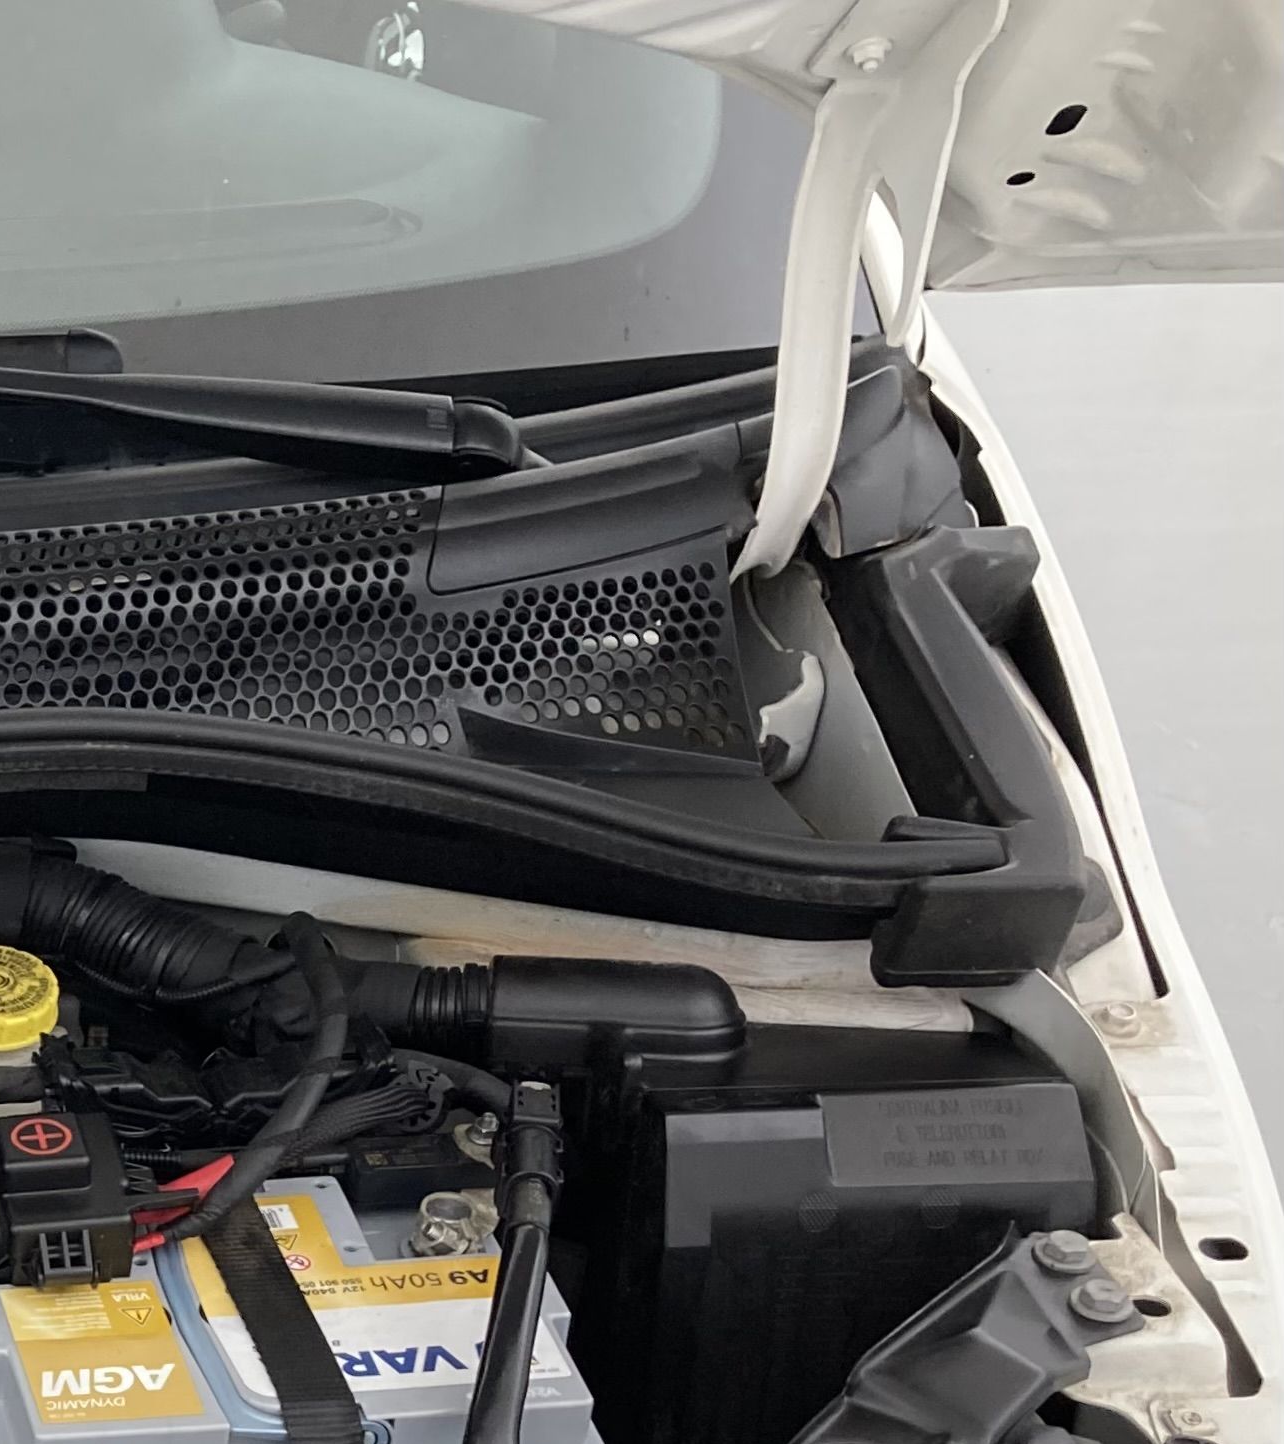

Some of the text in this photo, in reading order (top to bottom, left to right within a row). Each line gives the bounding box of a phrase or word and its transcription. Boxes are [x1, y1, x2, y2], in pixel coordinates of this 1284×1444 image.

[369, 1268, 490, 1292] A9 50Ah
[335, 1345, 468, 1378] VAR
[41, 1363, 176, 1397] AGM
[44, 1396, 126, 1411] DYNAMIC
